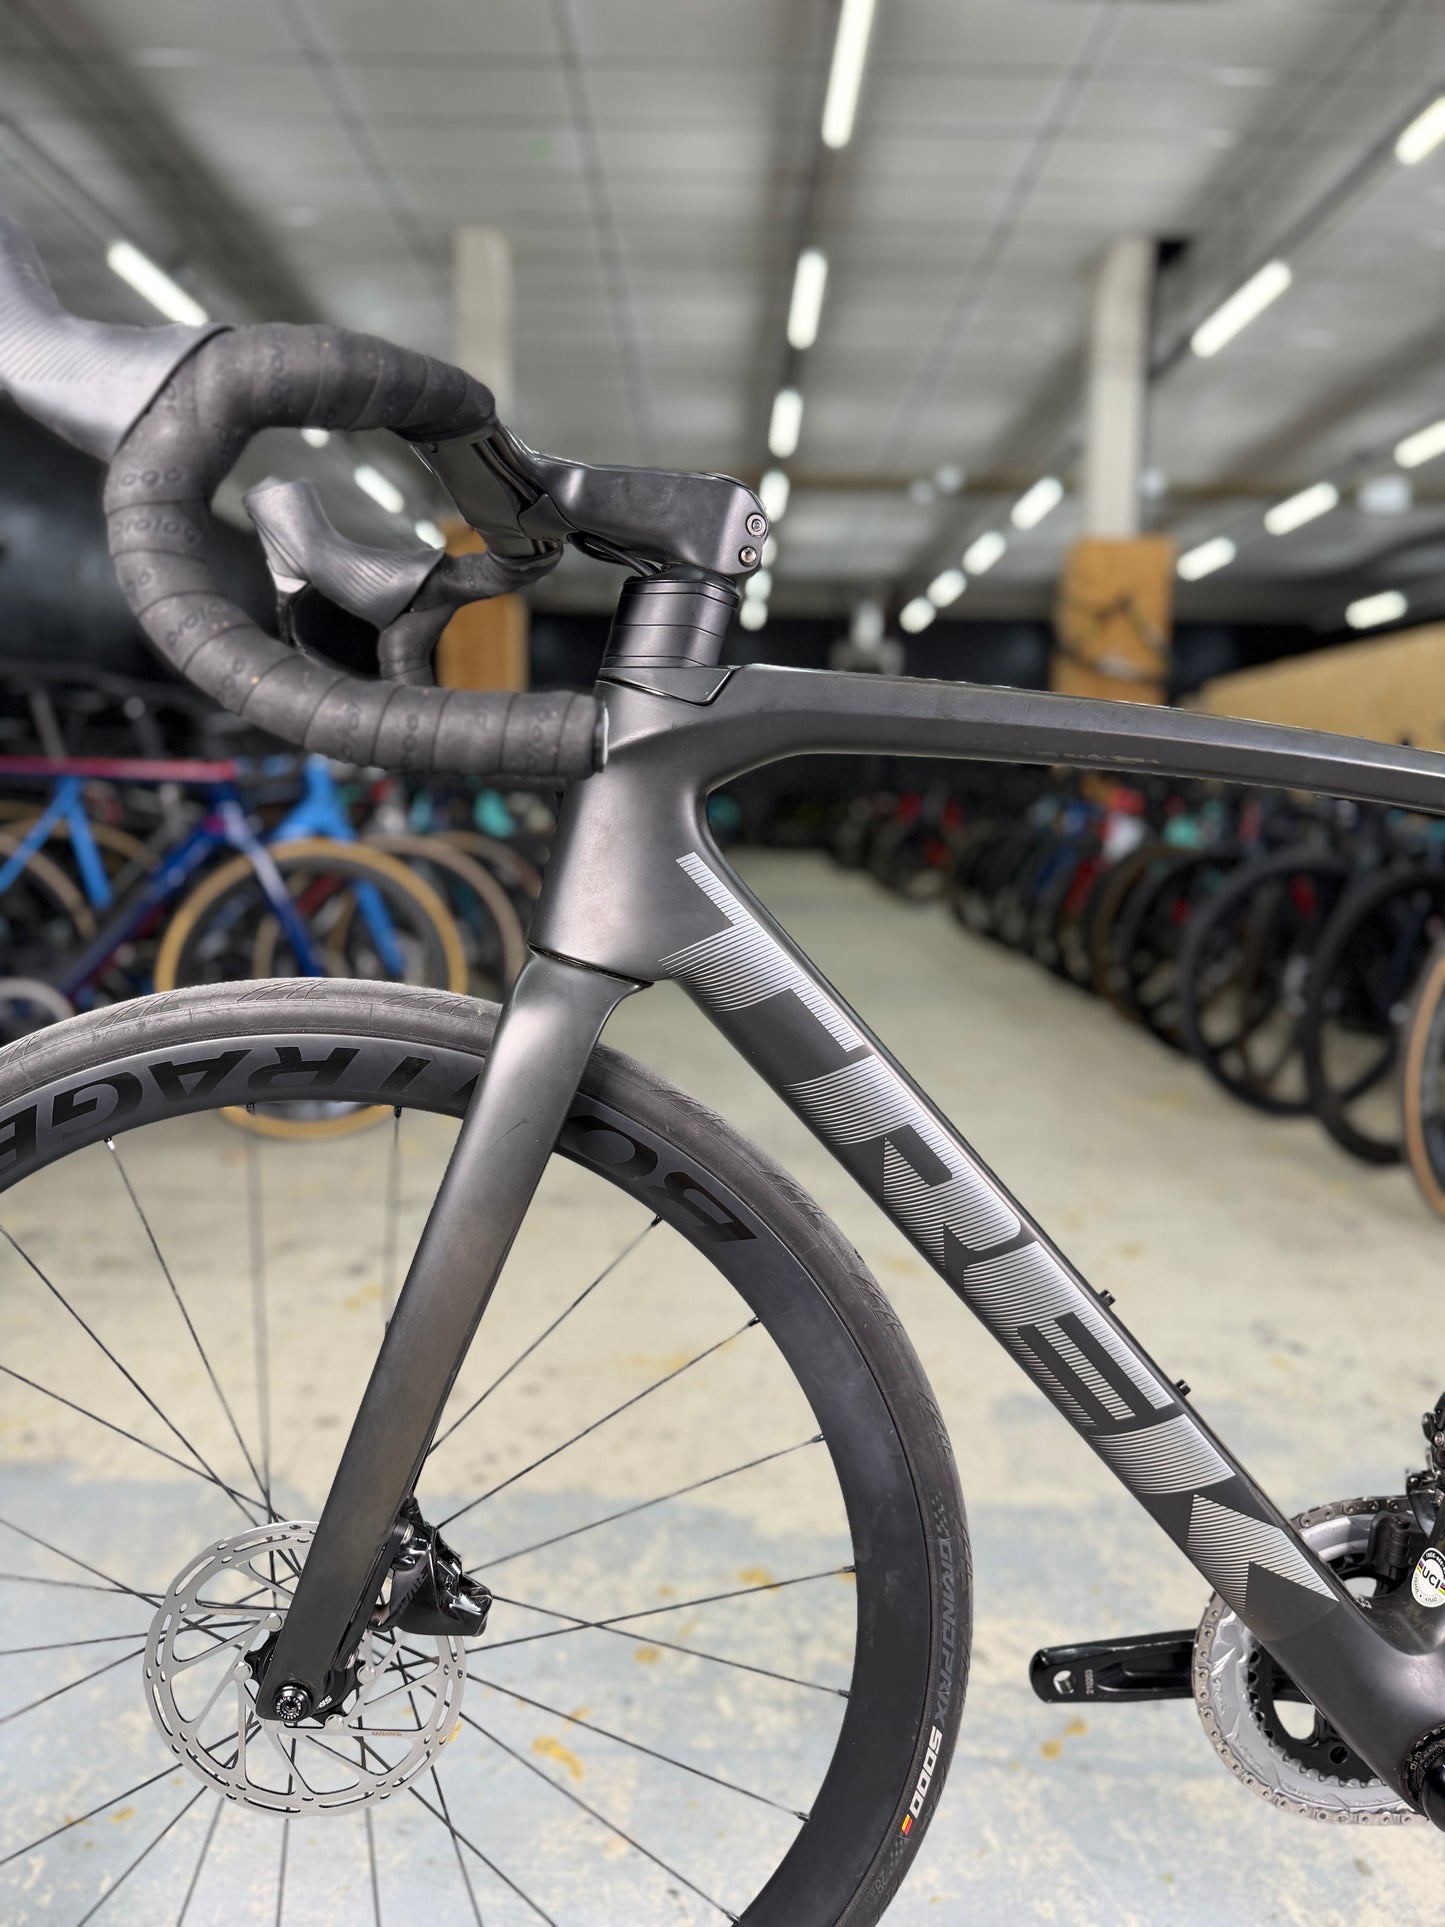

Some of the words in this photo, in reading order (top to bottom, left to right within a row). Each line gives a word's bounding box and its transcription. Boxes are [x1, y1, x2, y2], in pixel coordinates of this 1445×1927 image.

[0, 1046, 482, 1176] IRAGE
[558, 1114, 758, 1243] 50
[658, 851, 1340, 1614] TREK
[1421, 1565, 1441, 1589] UCI
[911, 1727, 942, 1819] 5000
